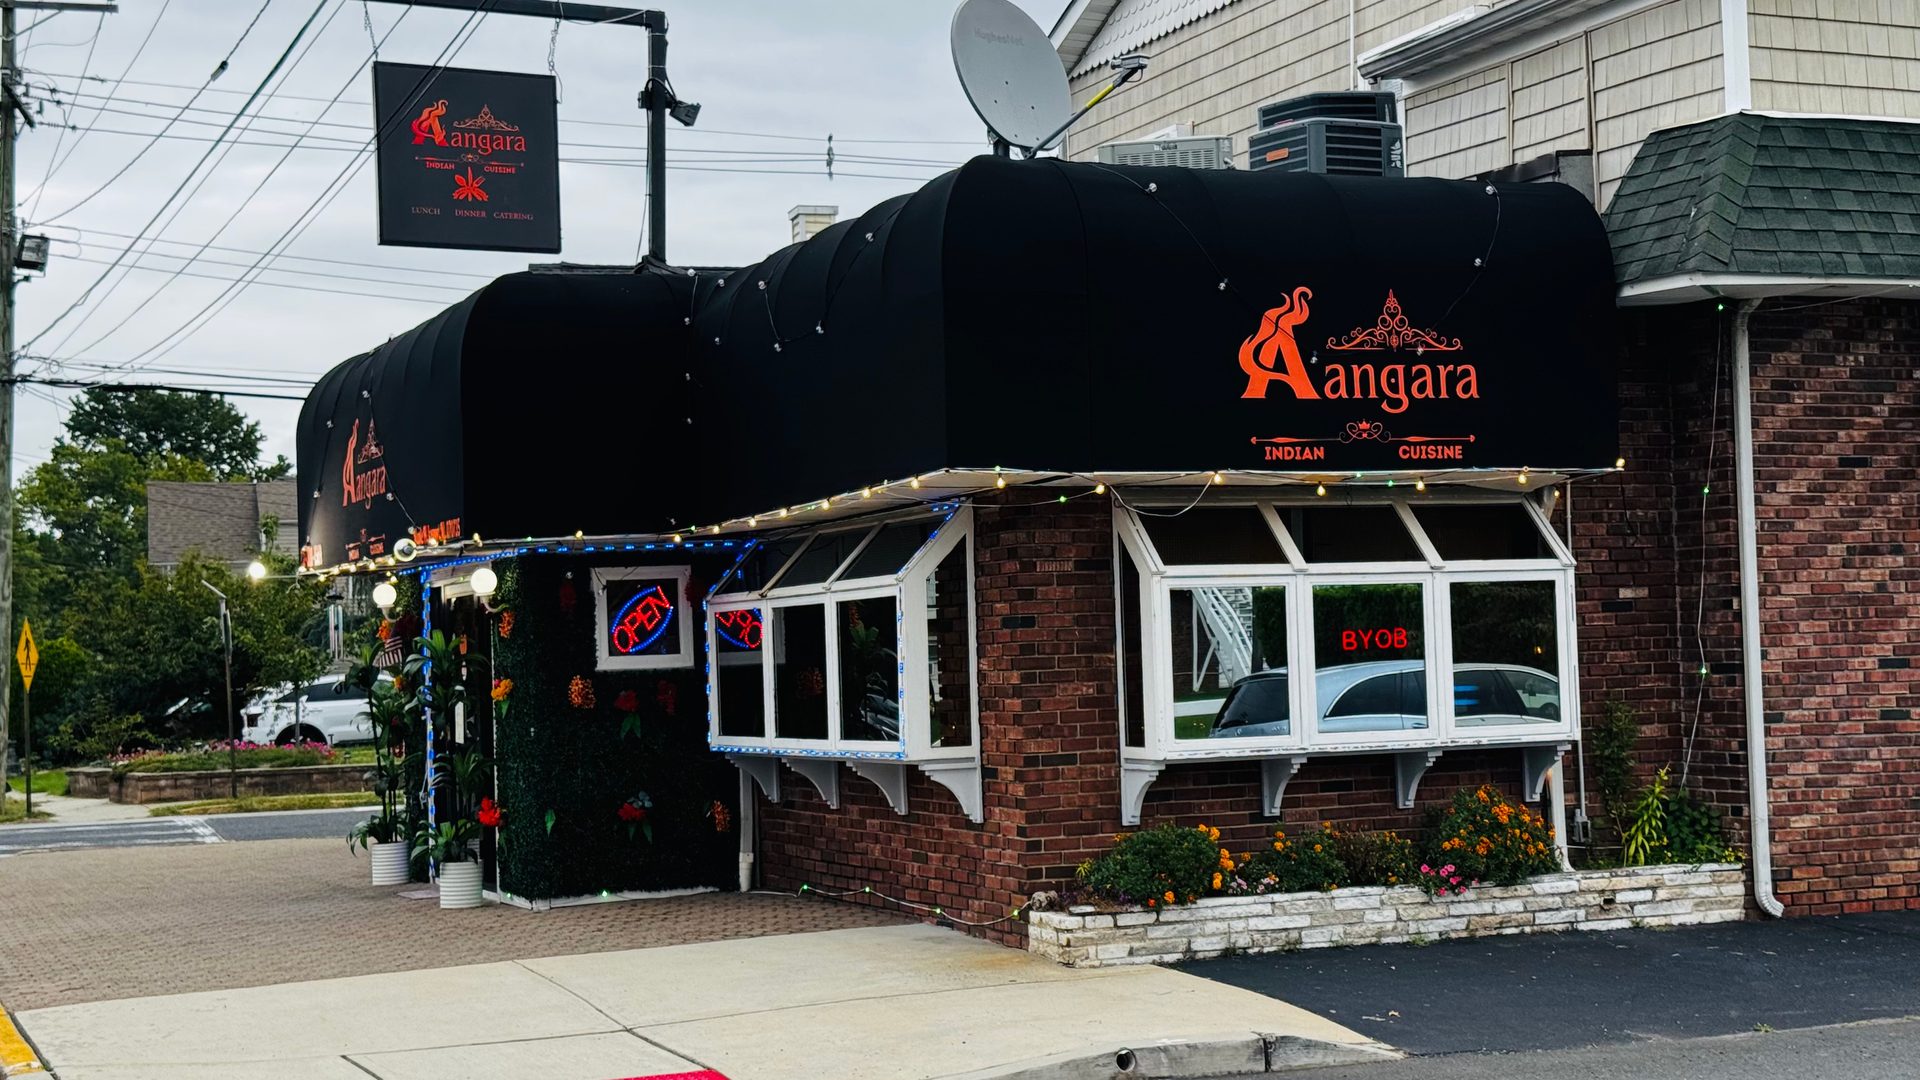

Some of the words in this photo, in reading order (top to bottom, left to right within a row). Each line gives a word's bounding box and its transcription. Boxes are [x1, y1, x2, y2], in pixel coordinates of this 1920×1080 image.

[426, 161, 455, 170] INDIAN
[484, 165, 516, 174] CUISINE
[411, 206, 441, 215] LUNCH
[455, 208, 487, 218] DINNER
[493, 211, 533, 221] CATERING
[1264, 446, 1325, 460] INDIAN
[1398, 445, 1463, 459] CUISINE
[612, 585, 671, 653] OPEN
[1342, 627, 1408, 651] BYOB
